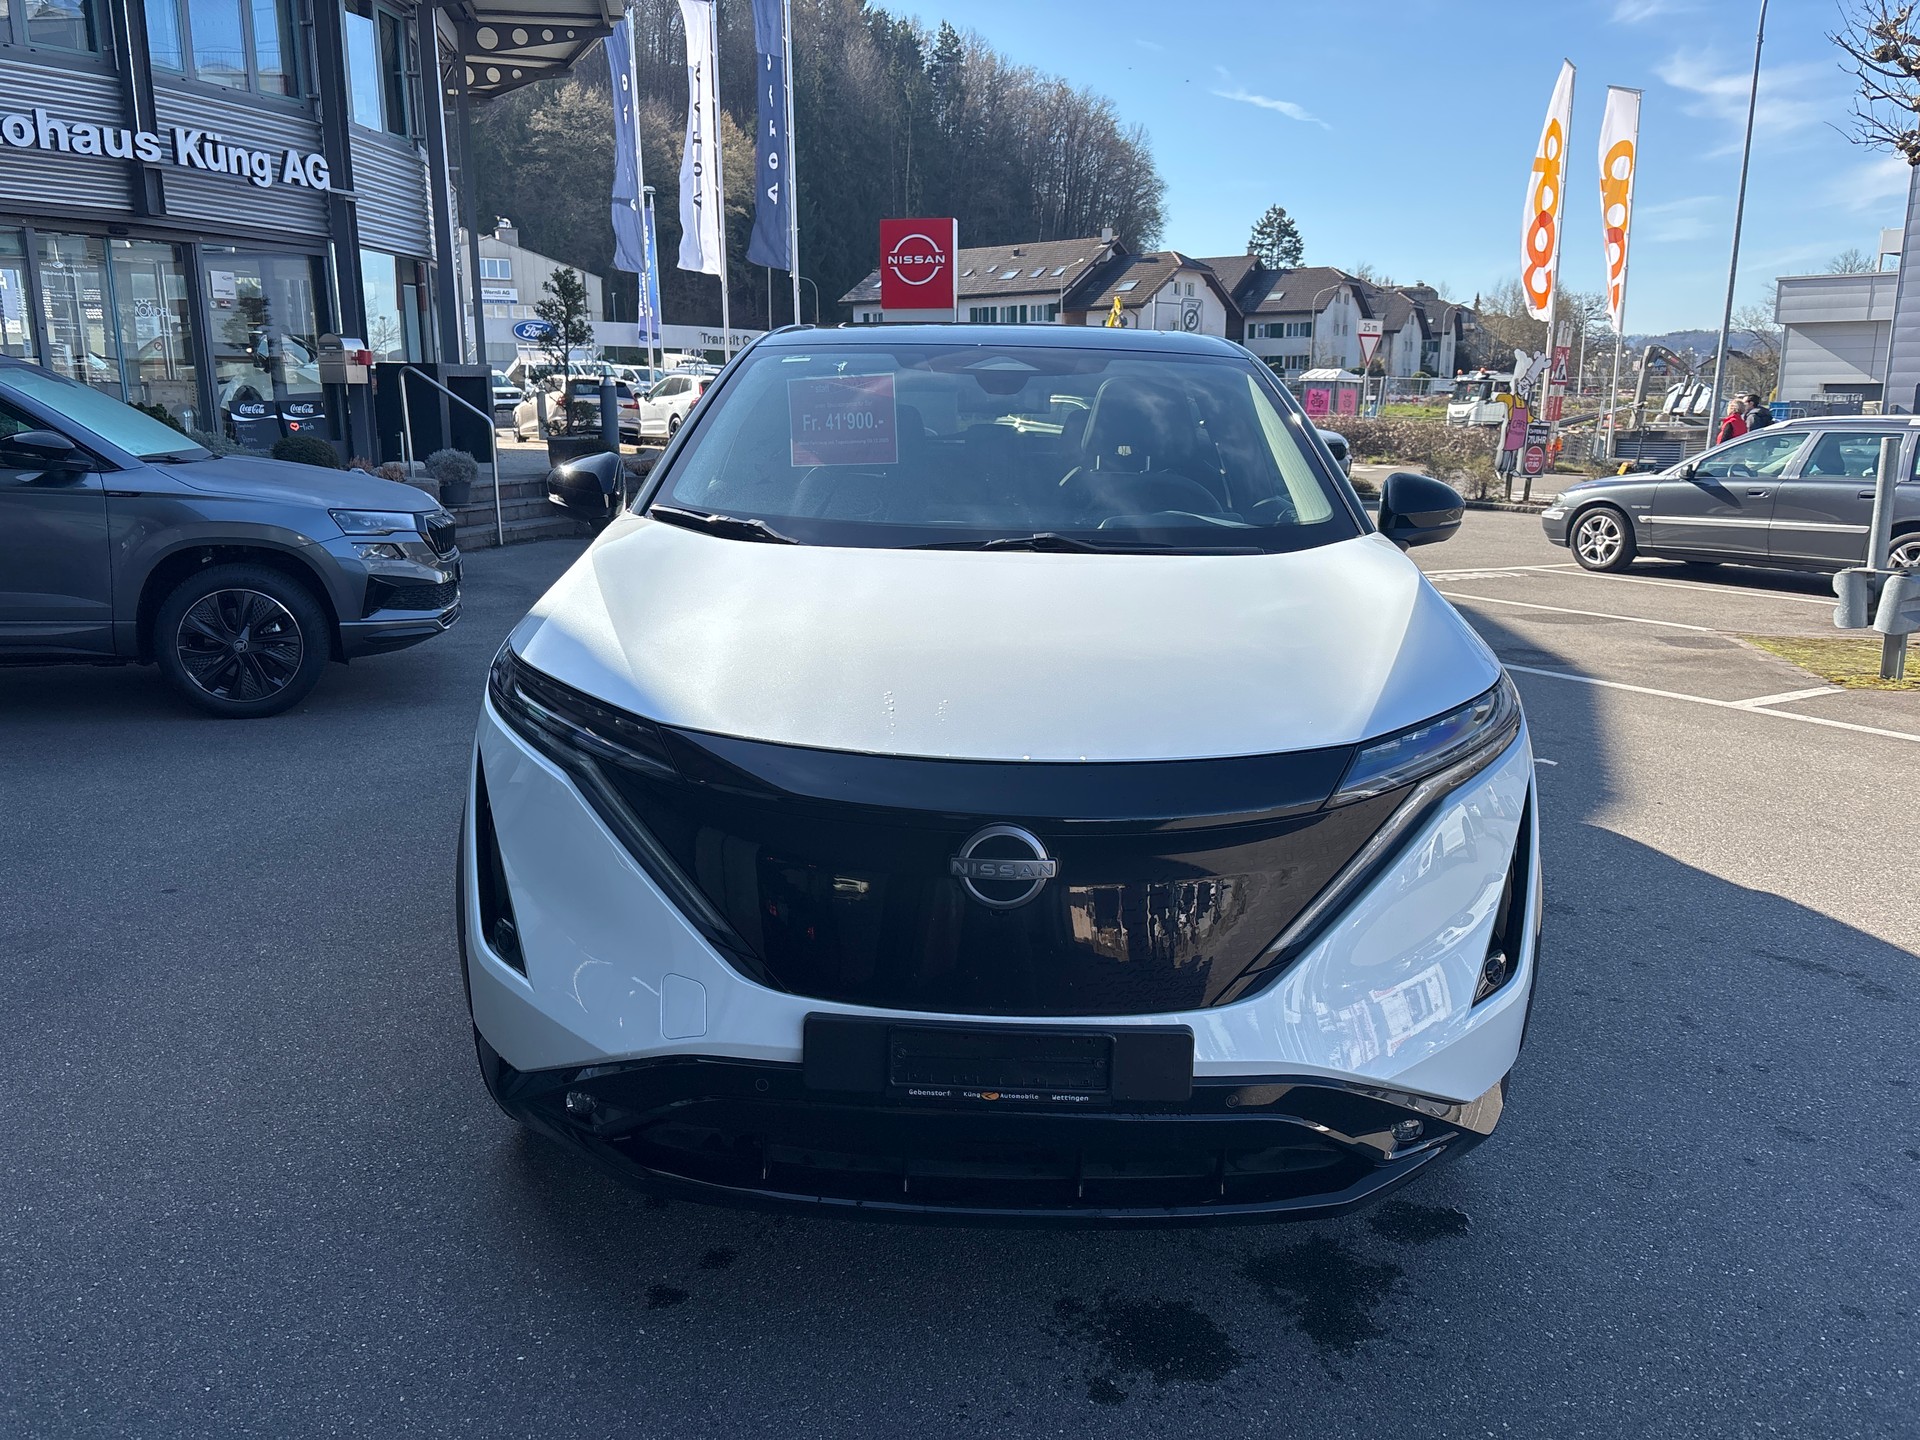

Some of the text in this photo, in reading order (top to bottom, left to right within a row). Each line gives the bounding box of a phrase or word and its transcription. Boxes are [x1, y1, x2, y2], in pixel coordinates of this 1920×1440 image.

[0, 108, 331, 191] ohaus Küng AG
[888, 255, 945, 264] NISSAN
[1363, 323, 1370, 331] 25
[701, 332, 740, 346] Transit
[802, 414, 821, 431] Fr.
[952, 861, 1053, 877] NISSAN
[909, 1089, 951, 1097] Gebenstorf
[963, 1091, 980, 1099] Küng
